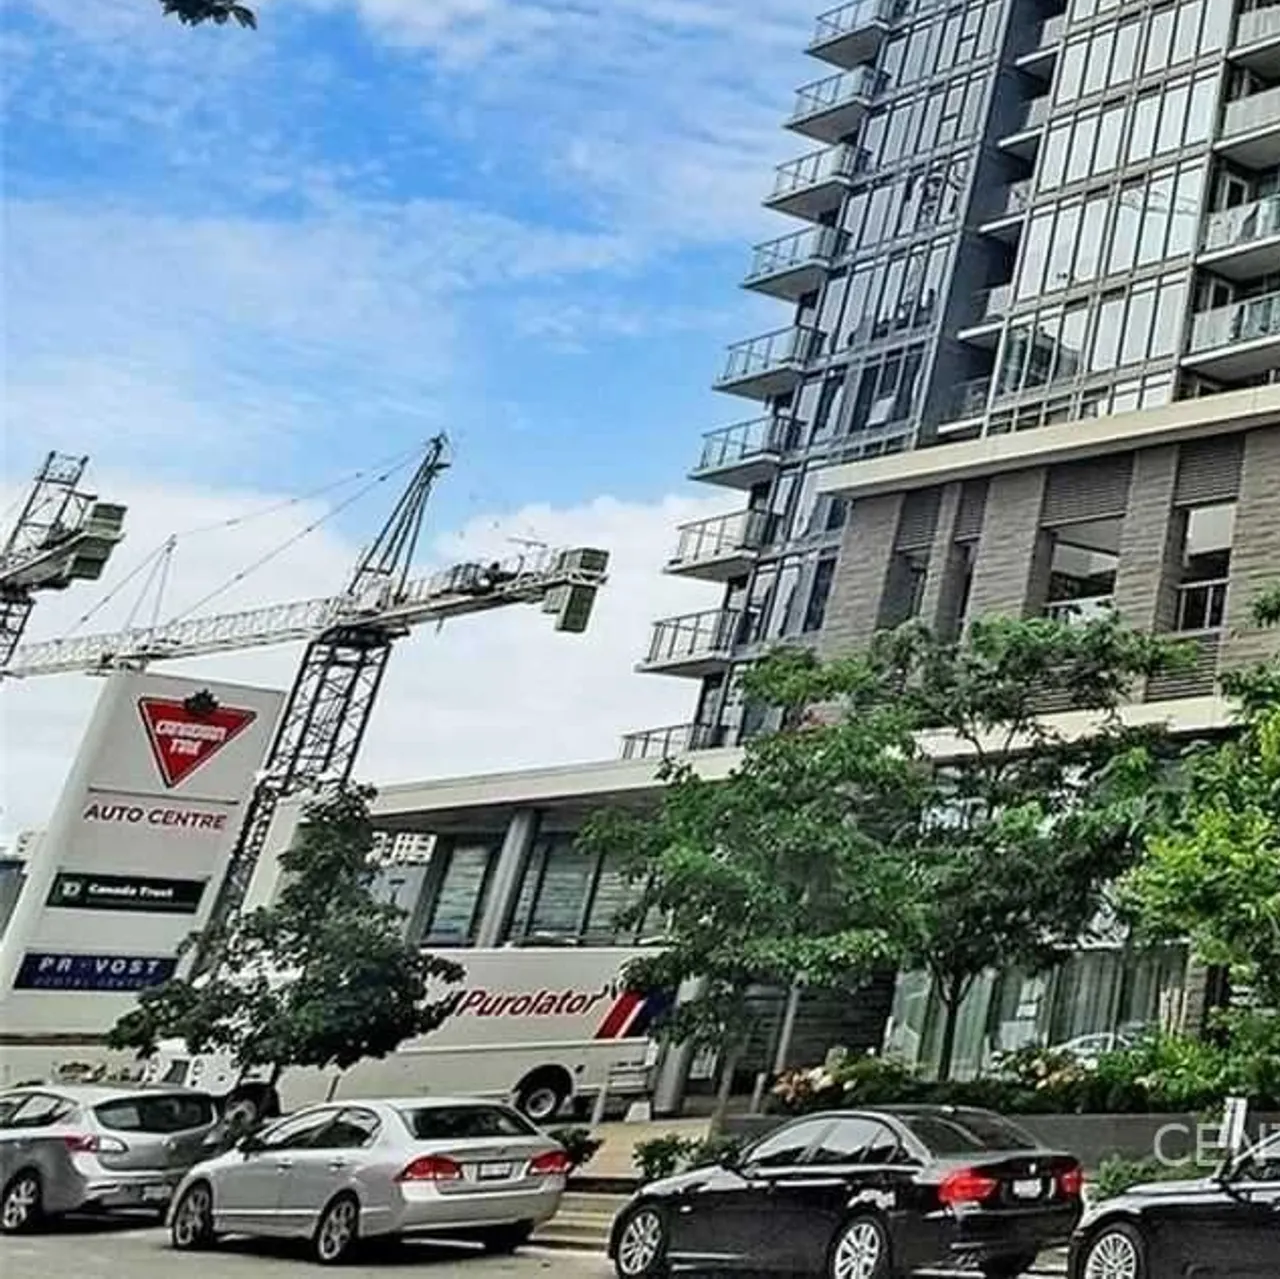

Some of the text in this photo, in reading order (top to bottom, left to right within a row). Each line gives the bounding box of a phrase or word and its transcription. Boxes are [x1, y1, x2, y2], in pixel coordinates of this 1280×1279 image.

[84, 803, 228, 830] AUTO CENTRE
[88, 882, 137, 897] Canada
[140, 885, 174, 898] Trust
[38, 956, 161, 976] PRVOST
[455, 989, 600, 1017] Purolator
